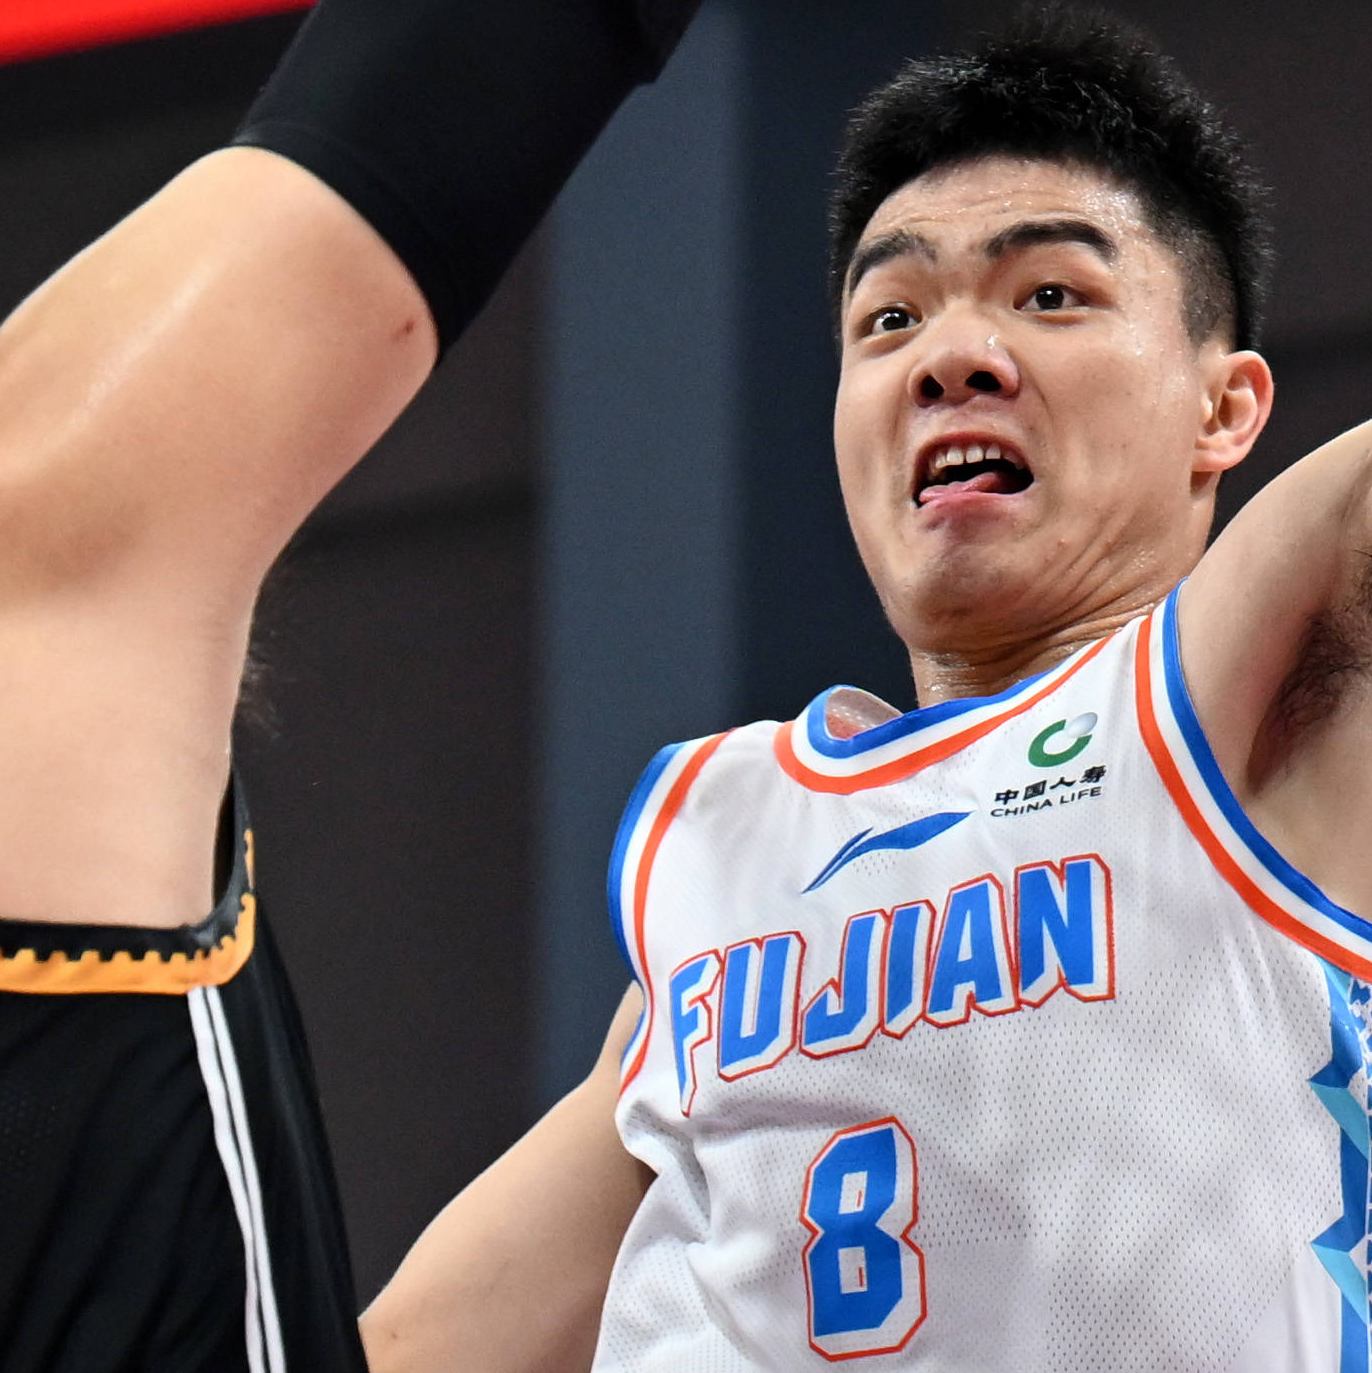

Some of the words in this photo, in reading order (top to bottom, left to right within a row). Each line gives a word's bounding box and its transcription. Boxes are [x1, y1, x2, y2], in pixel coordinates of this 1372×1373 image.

[990, 799, 1052, 817] CHINA
[1060, 786, 1102, 804] LIFE
[994, 765, 1106, 805] 中国人寿
[669, 854, 1115, 1116] FUJIAN
[801, 1116, 926, 1362] 8
